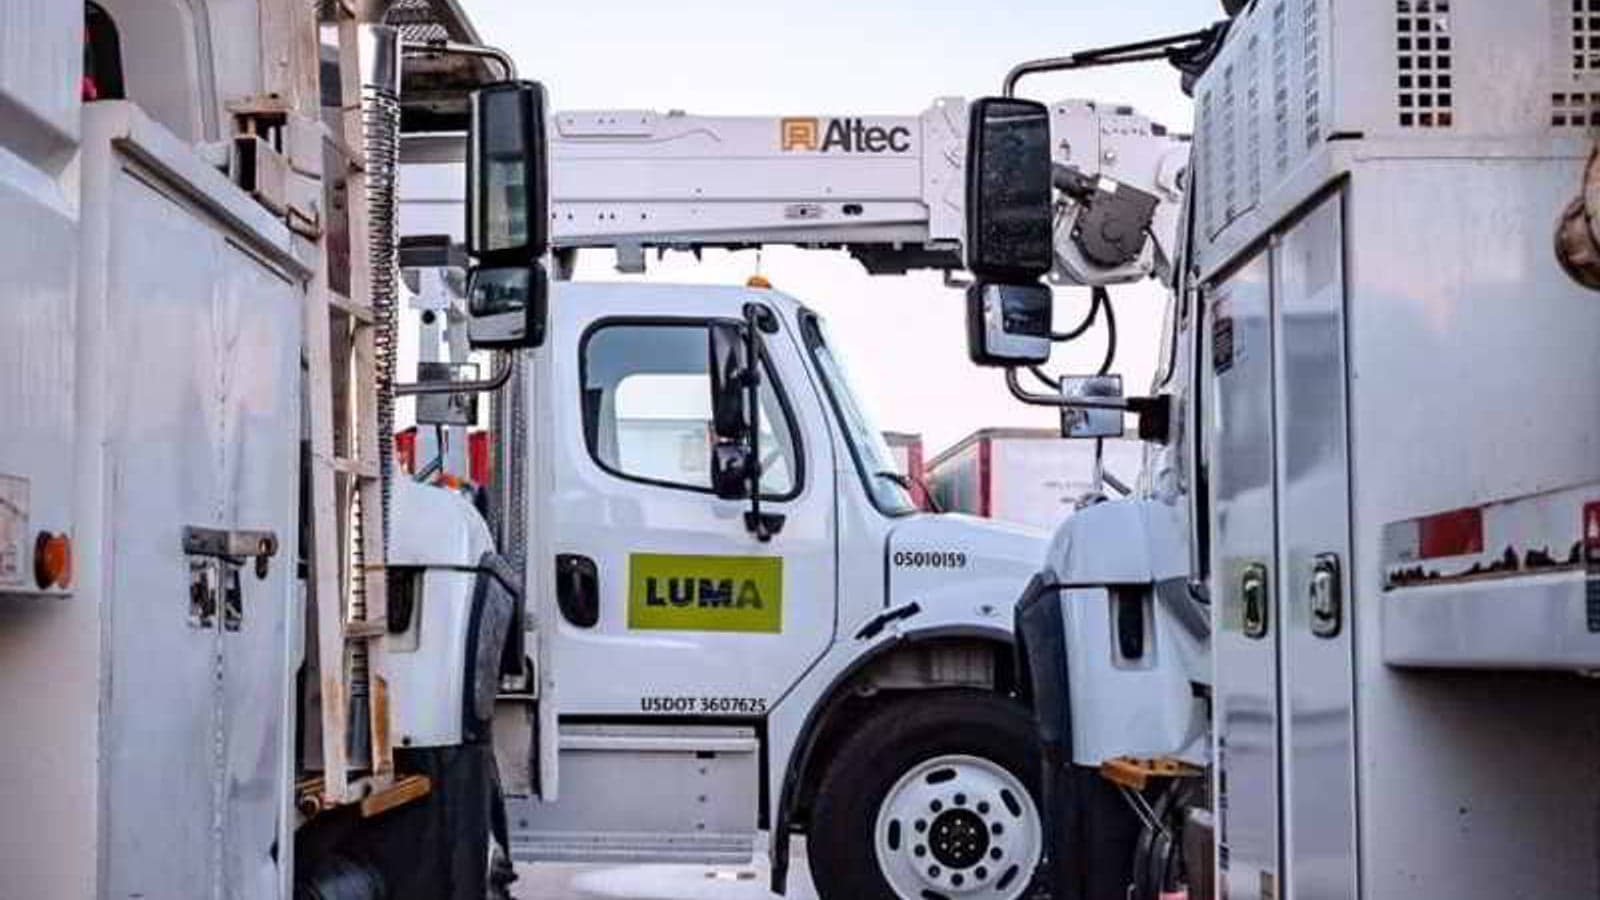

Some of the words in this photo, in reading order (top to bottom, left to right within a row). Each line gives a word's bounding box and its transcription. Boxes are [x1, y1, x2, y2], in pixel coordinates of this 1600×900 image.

[821, 117, 910, 153] Altec
[894, 551, 966, 568] 05010159
[645, 577, 764, 610] LUMA
[641, 697, 697, 712] USDOT
[700, 697, 767, 712] 3607625
